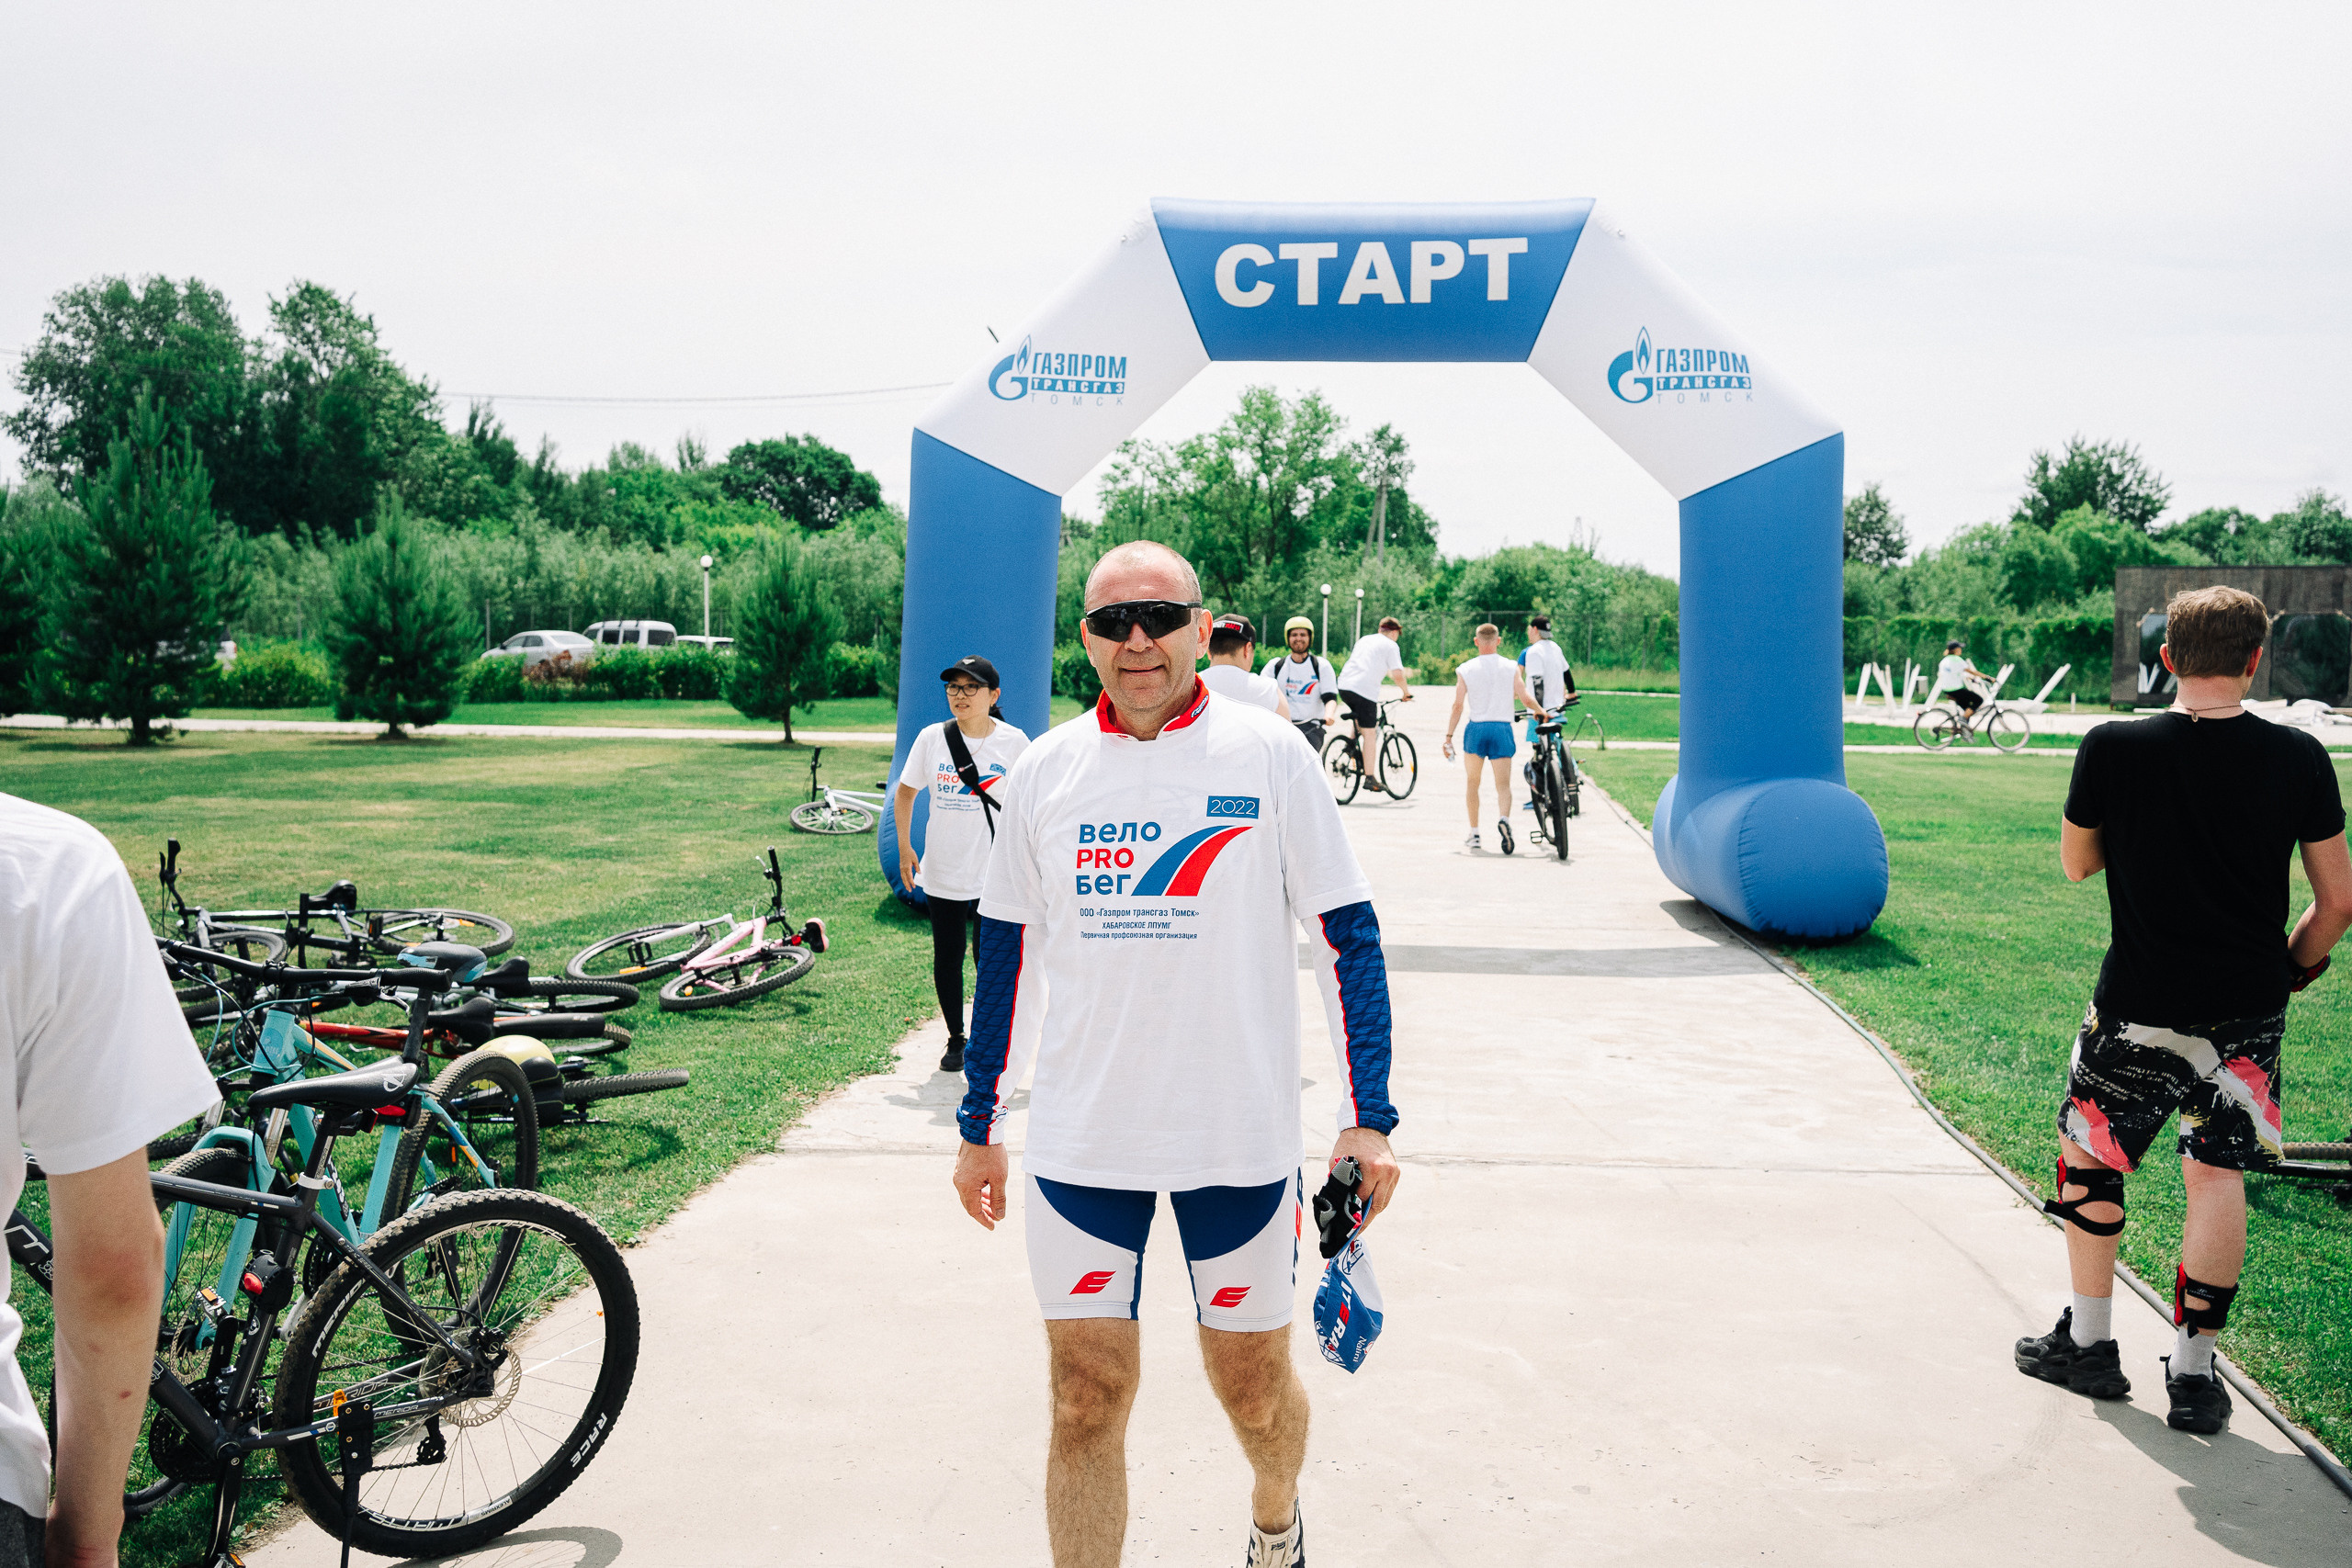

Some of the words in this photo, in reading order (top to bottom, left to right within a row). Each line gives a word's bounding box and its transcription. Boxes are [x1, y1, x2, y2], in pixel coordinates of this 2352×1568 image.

[1214, 236, 1529, 308] СТАРТ
[1032, 353, 1126, 378] ГАЗПРОМ
[1657, 348, 1749, 374] ГАЗПРОМ
[1032, 378, 1125, 393] ТРАНСГАЗ
[1657, 376, 1751, 390] ТРАНСГАЗ
[1031, 392, 1124, 406] ТОМСК
[1657, 391, 1753, 404] ТОМСК
[937, 773, 960, 784] PRO
[1210, 799, 1256, 816] 2022
[1076, 848, 1134, 869] PRO
[1096, 908, 1131, 918] «Газпром
[1133, 908, 1169, 918] трансгаз
[1170, 908, 1199, 917] Томск»
[1102, 921, 1146, 930] ХАБАРОВСКОЕ
[1148, 921, 1171, 930] ЛПУМГ
[1111, 931, 1154, 941] профсоюзная
[311, 1277, 367, 1359] MERID
[1352, 1336, 1367, 1363] Nalini
[314, 1378, 388, 1408] MRIDA
[571, 1412, 607, 1468] RACE
